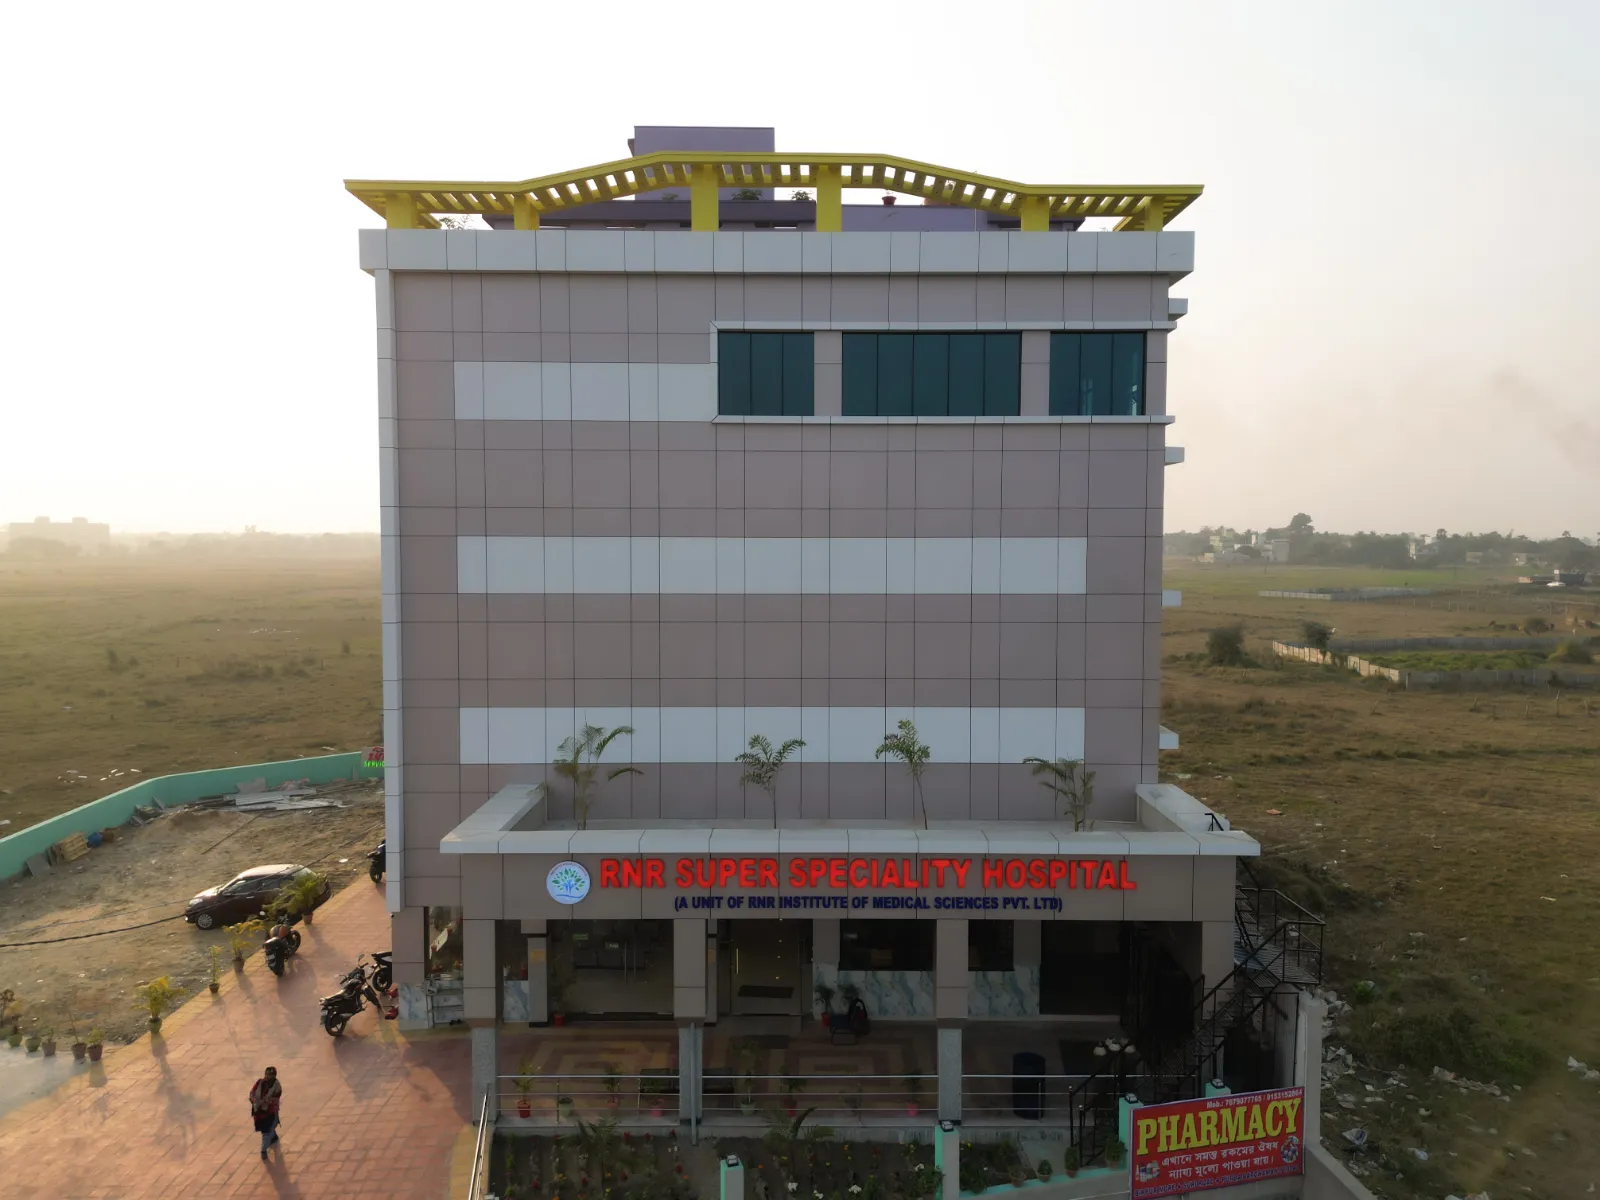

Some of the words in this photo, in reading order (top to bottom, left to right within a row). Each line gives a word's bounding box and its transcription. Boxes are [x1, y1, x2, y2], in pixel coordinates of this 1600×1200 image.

[600, 859, 666, 889] RNR
[675, 858, 779, 889] SUPER
[789, 858, 972, 889] SPECIALITY
[983, 859, 1137, 890] HOSPITAL
[674, 896, 688, 911] (A
[692, 896, 722, 909] UNIT
[727, 896, 744, 909] OF
[748, 896, 775, 909] RNR
[779, 896, 848, 909] INSTITUTE
[852, 896, 868, 909] OF
[873, 896, 930, 909] MEDICAL
[934, 896, 998, 909] SCIENCES
[1002, 896, 1030, 909] PVT.
[1034, 896, 1063, 912] LTD)
[1136, 1097, 1302, 1156] PHARMACY
